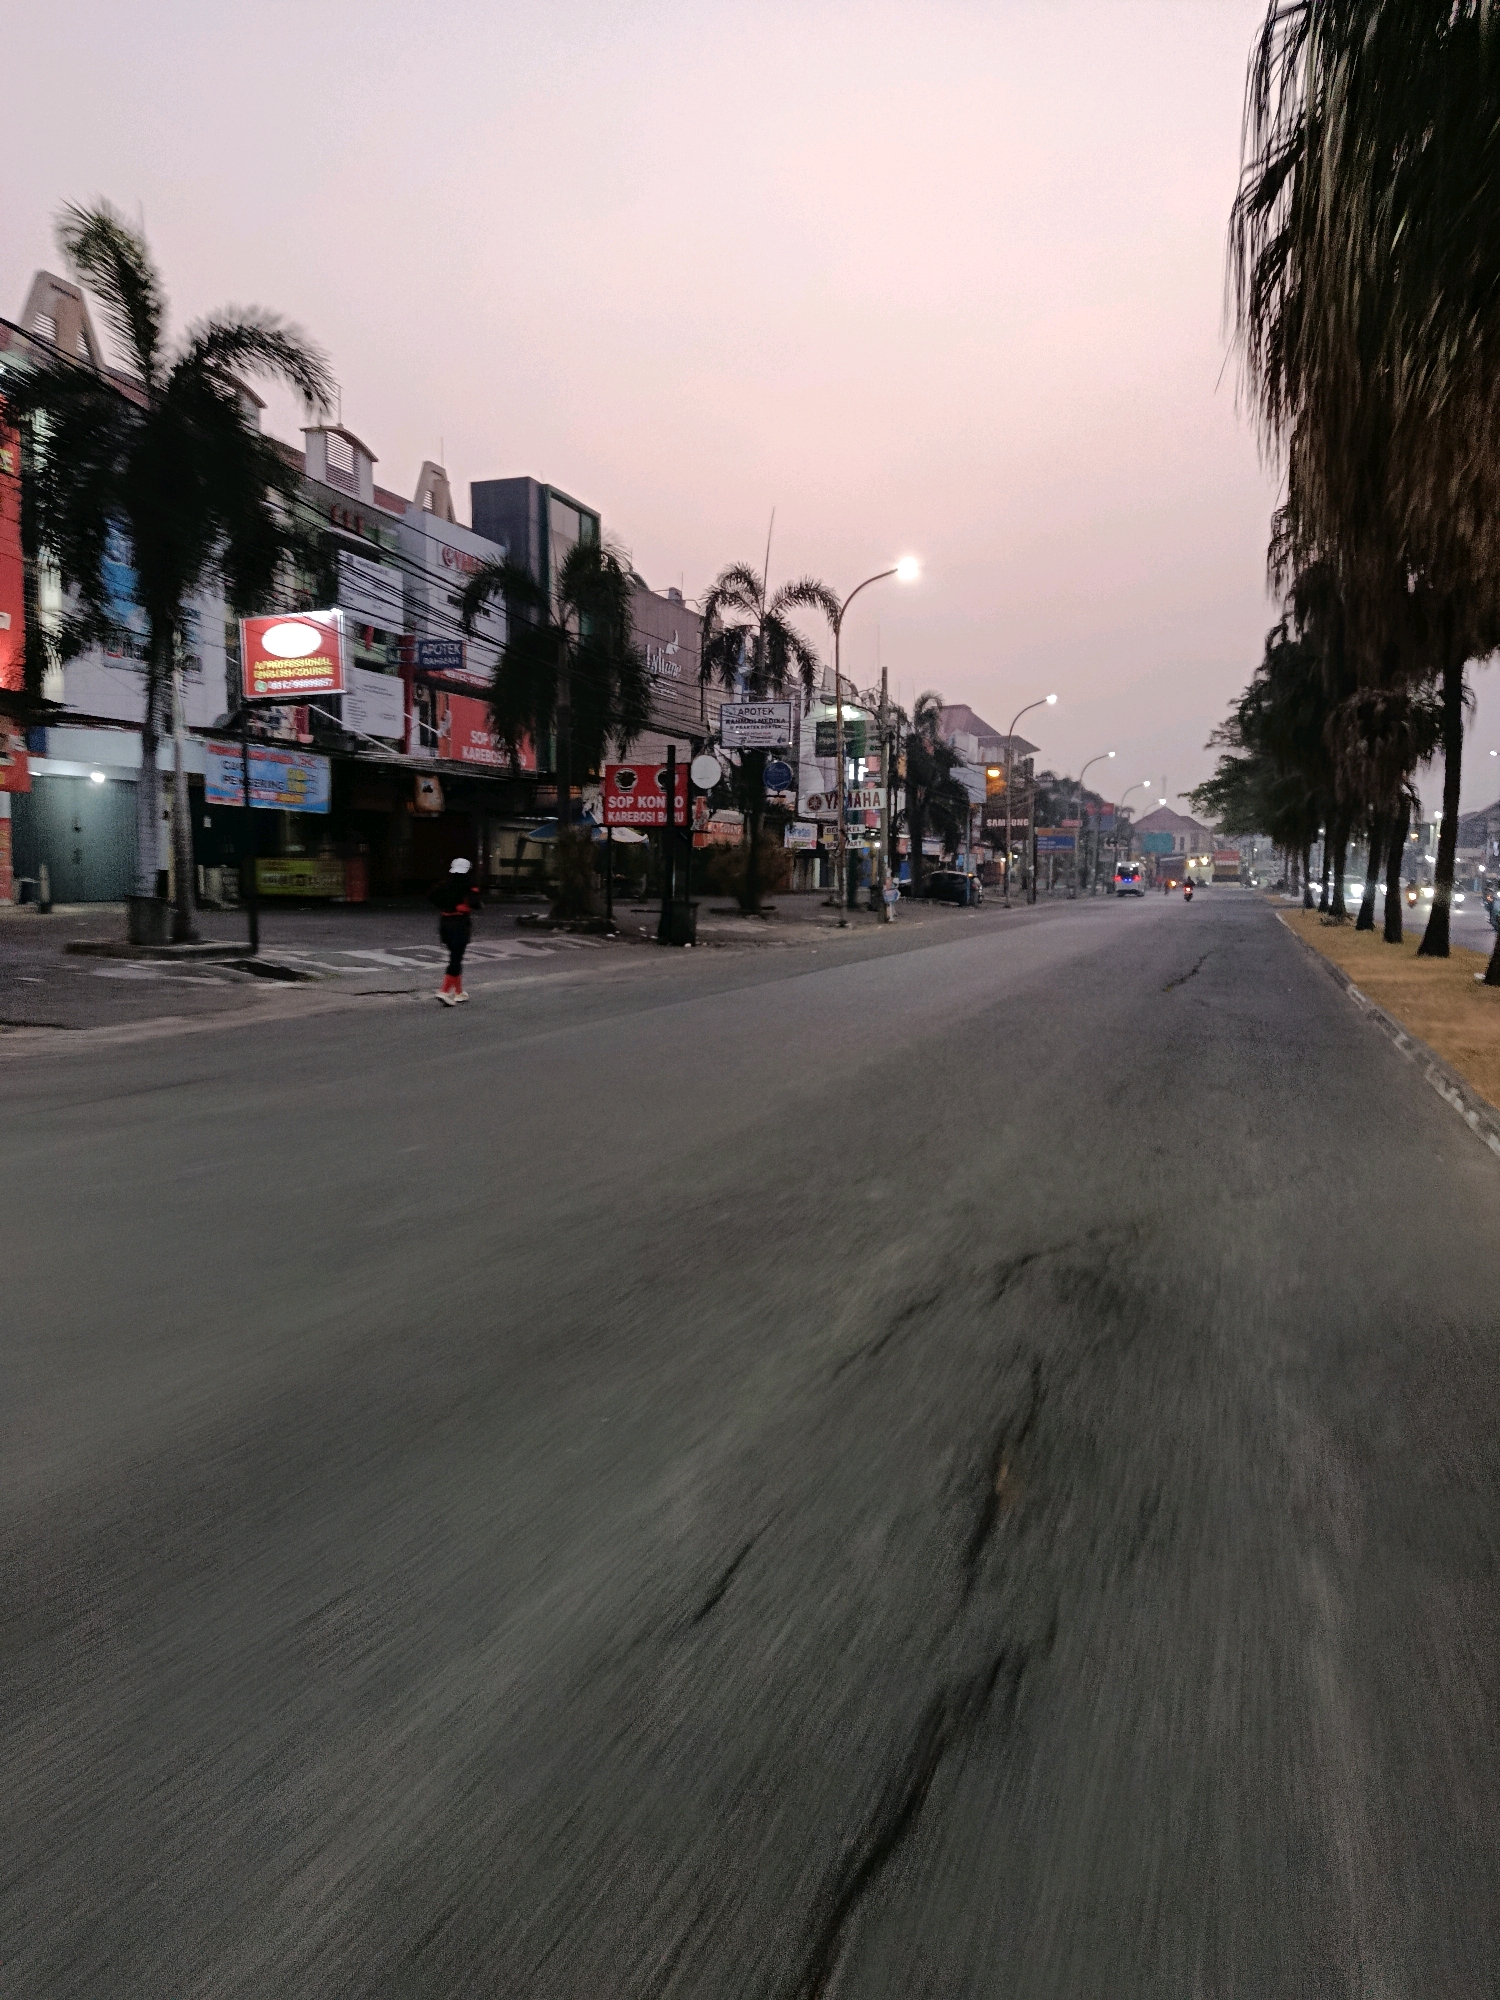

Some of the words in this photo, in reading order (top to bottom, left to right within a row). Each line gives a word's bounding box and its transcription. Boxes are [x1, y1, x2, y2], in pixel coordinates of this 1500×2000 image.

[422, 644, 461, 656] APOTEK
[294, 666, 334, 677] COURSE
[738, 707, 775, 716] APOTEK
[470, 730, 488, 746] SOP
[608, 796, 634, 808] SOP
[637, 796, 684, 808] KONO
[608, 812, 655, 823] KAREBOSI
[986, 818, 1029, 827] SAMUNG
